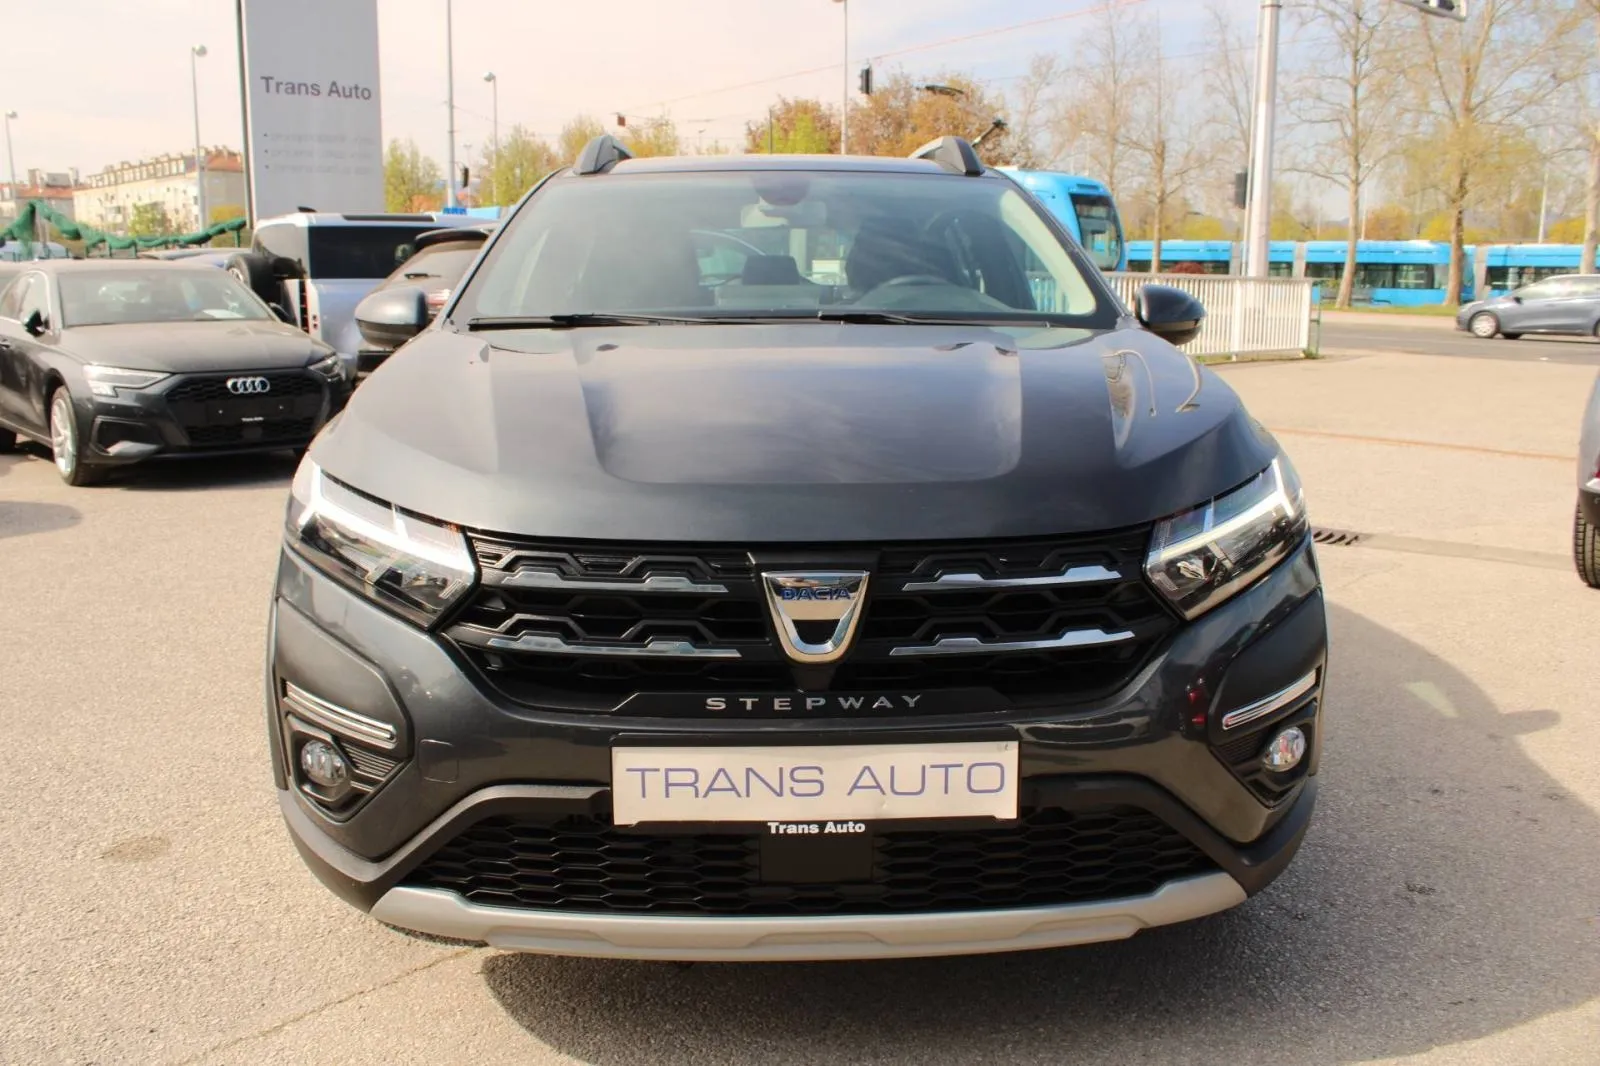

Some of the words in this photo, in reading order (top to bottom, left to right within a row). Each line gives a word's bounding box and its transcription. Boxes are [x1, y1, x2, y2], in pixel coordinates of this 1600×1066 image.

[260, 76, 321, 97] Trans
[328, 80, 372, 101] Auto
[781, 587, 851, 600] DACIA
[705, 694, 922, 711] STEPWAY
[626, 765, 825, 799] TRANS
[847, 761, 1005, 797] AUTO
[767, 821, 819, 835] Trans
[824, 821, 866, 834] Auto
